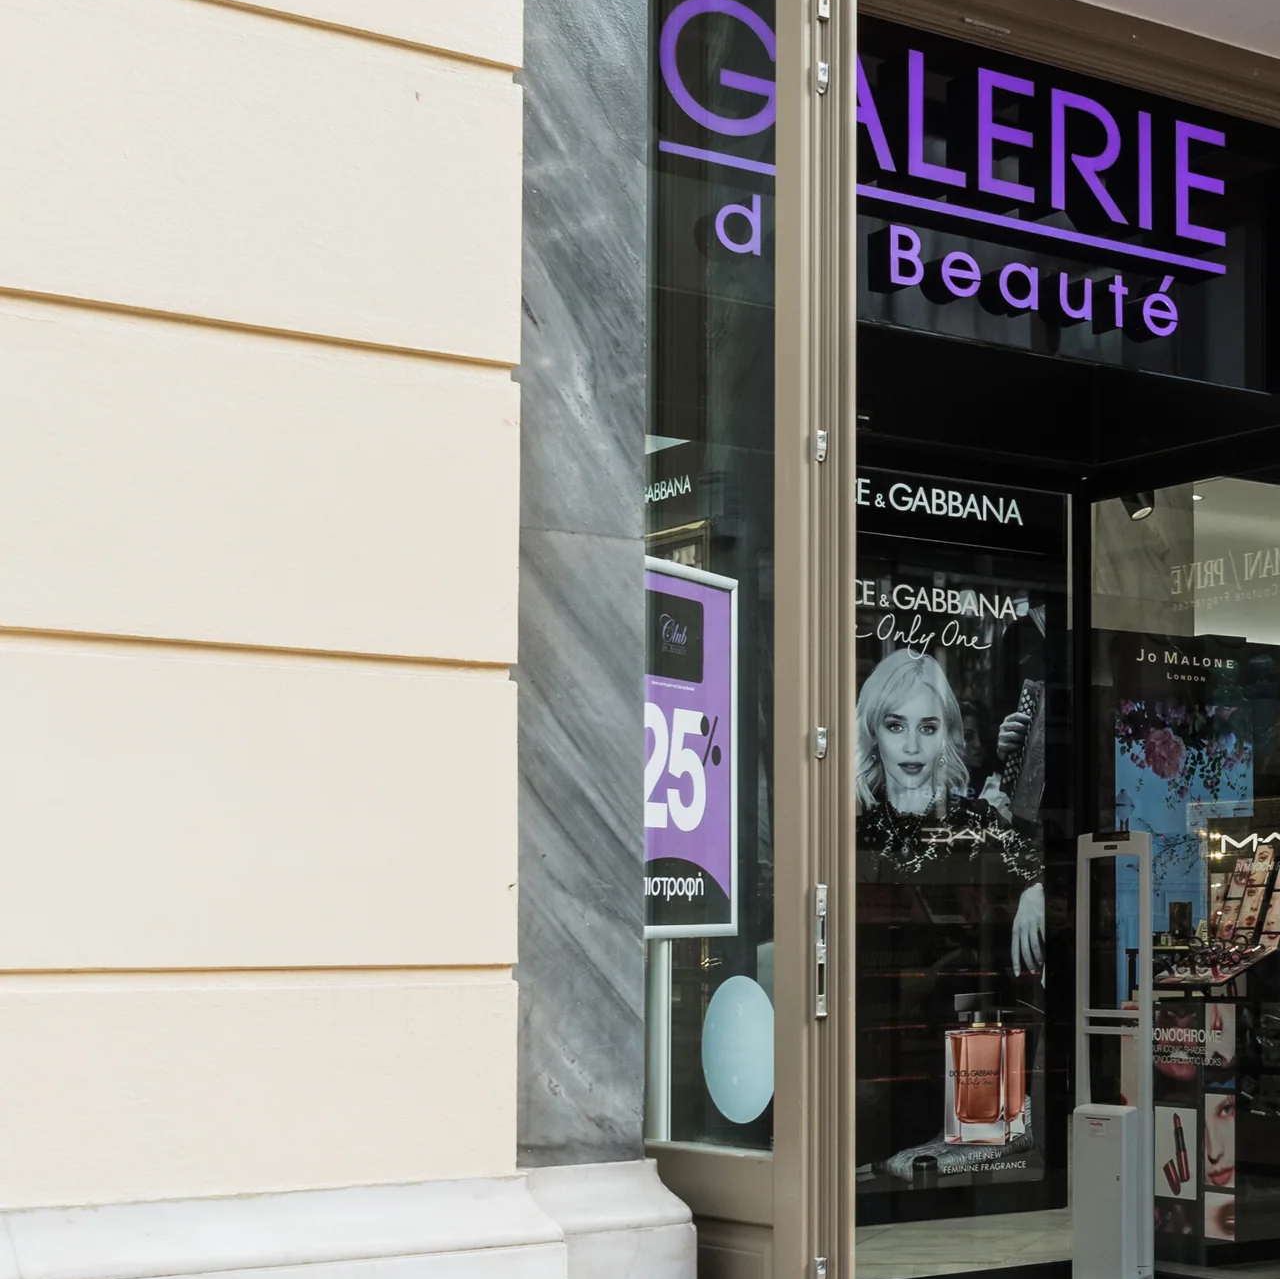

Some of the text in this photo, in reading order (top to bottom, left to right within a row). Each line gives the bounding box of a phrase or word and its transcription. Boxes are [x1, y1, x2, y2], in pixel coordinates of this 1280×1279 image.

[889, 224, 1178, 337] Beauté
[889, 483, 1024, 526] GABBANA
[892, 584, 1018, 621] GABBANA
[877, 613, 992, 660] Only One
[1152, 1027, 1221, 1044] ONOCHROME
[943, 1160, 1027, 1174] FEMININE FRAGRANCE
[983, 1151, 1002, 1160] NEW
